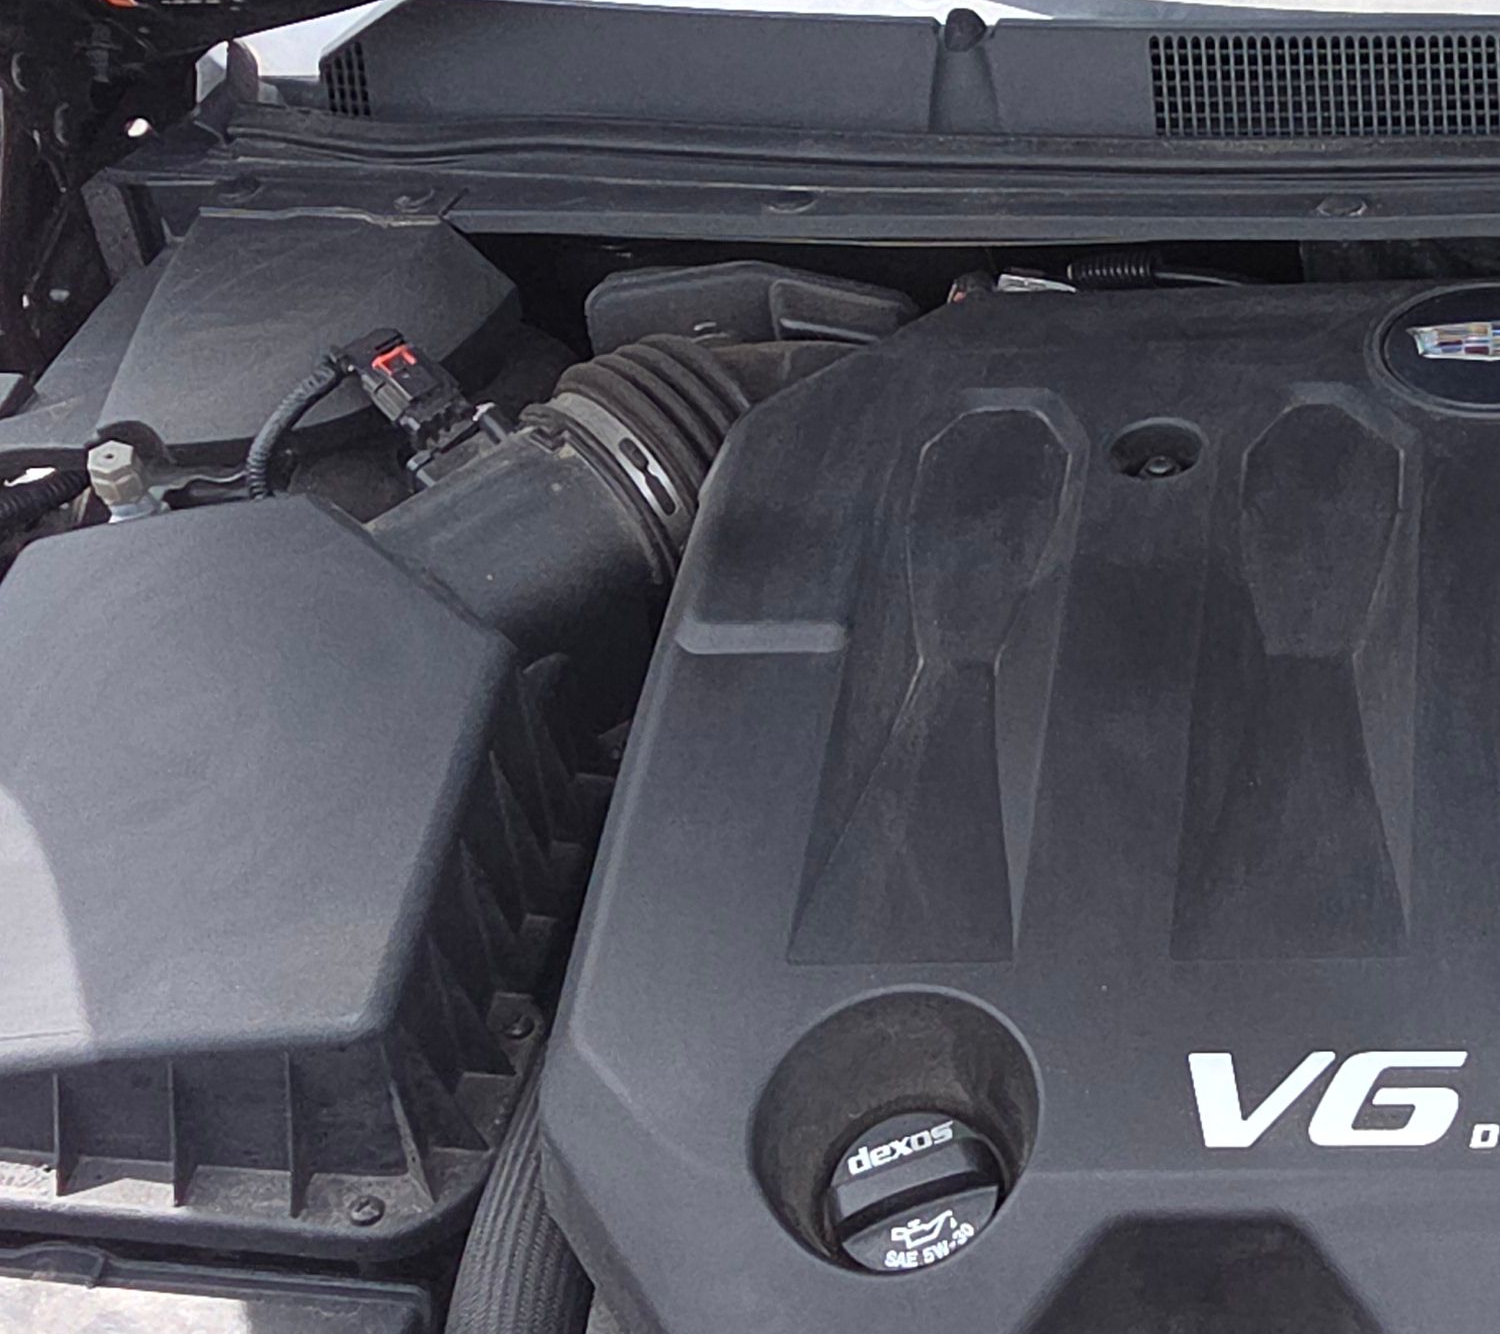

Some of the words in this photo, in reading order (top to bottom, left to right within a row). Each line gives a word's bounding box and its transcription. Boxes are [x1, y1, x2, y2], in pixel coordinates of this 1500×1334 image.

[1188, 1051, 1468, 1148] V6
[847, 1120, 954, 1176] dexos
[883, 1249, 919, 1269] SAE
[921, 1223, 975, 1265] 5W-30
